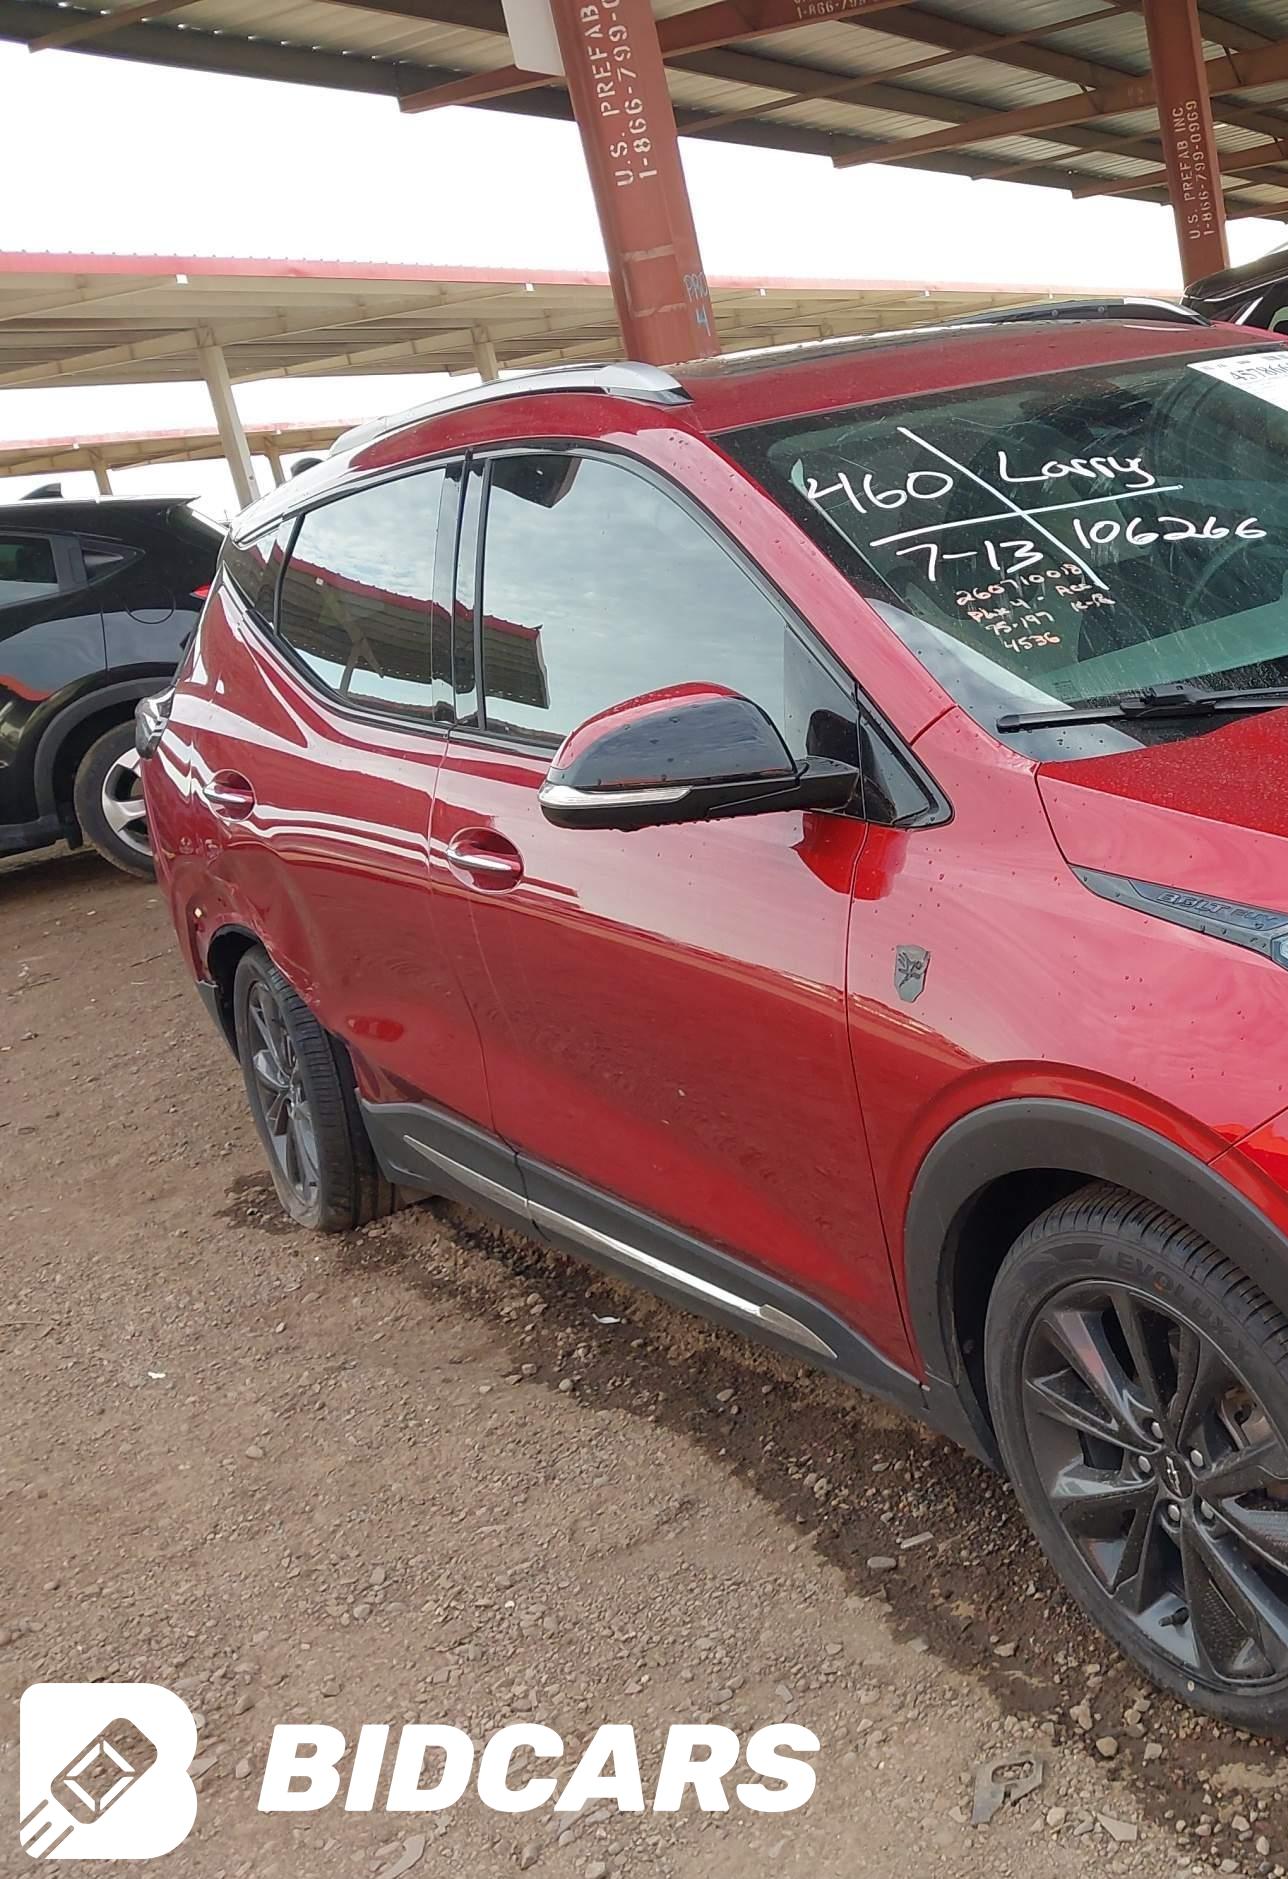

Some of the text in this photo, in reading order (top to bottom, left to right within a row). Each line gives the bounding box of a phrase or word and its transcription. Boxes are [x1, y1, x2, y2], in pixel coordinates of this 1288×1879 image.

[580, 4, 621, 117] PREFAB
[1176, 140, 1197, 201] PREFAB
[1185, 100, 1215, 236] 1-866-799-0969
[997, 450, 1157, 488] Larry
[806, 470, 955, 515] 460
[1072, 517, 1268, 552] 106266
[896, 538, 1044, 582] 7-13
[1003, 631, 1061, 654] 4536
[1156, 891, 1233, 914] BOLT
